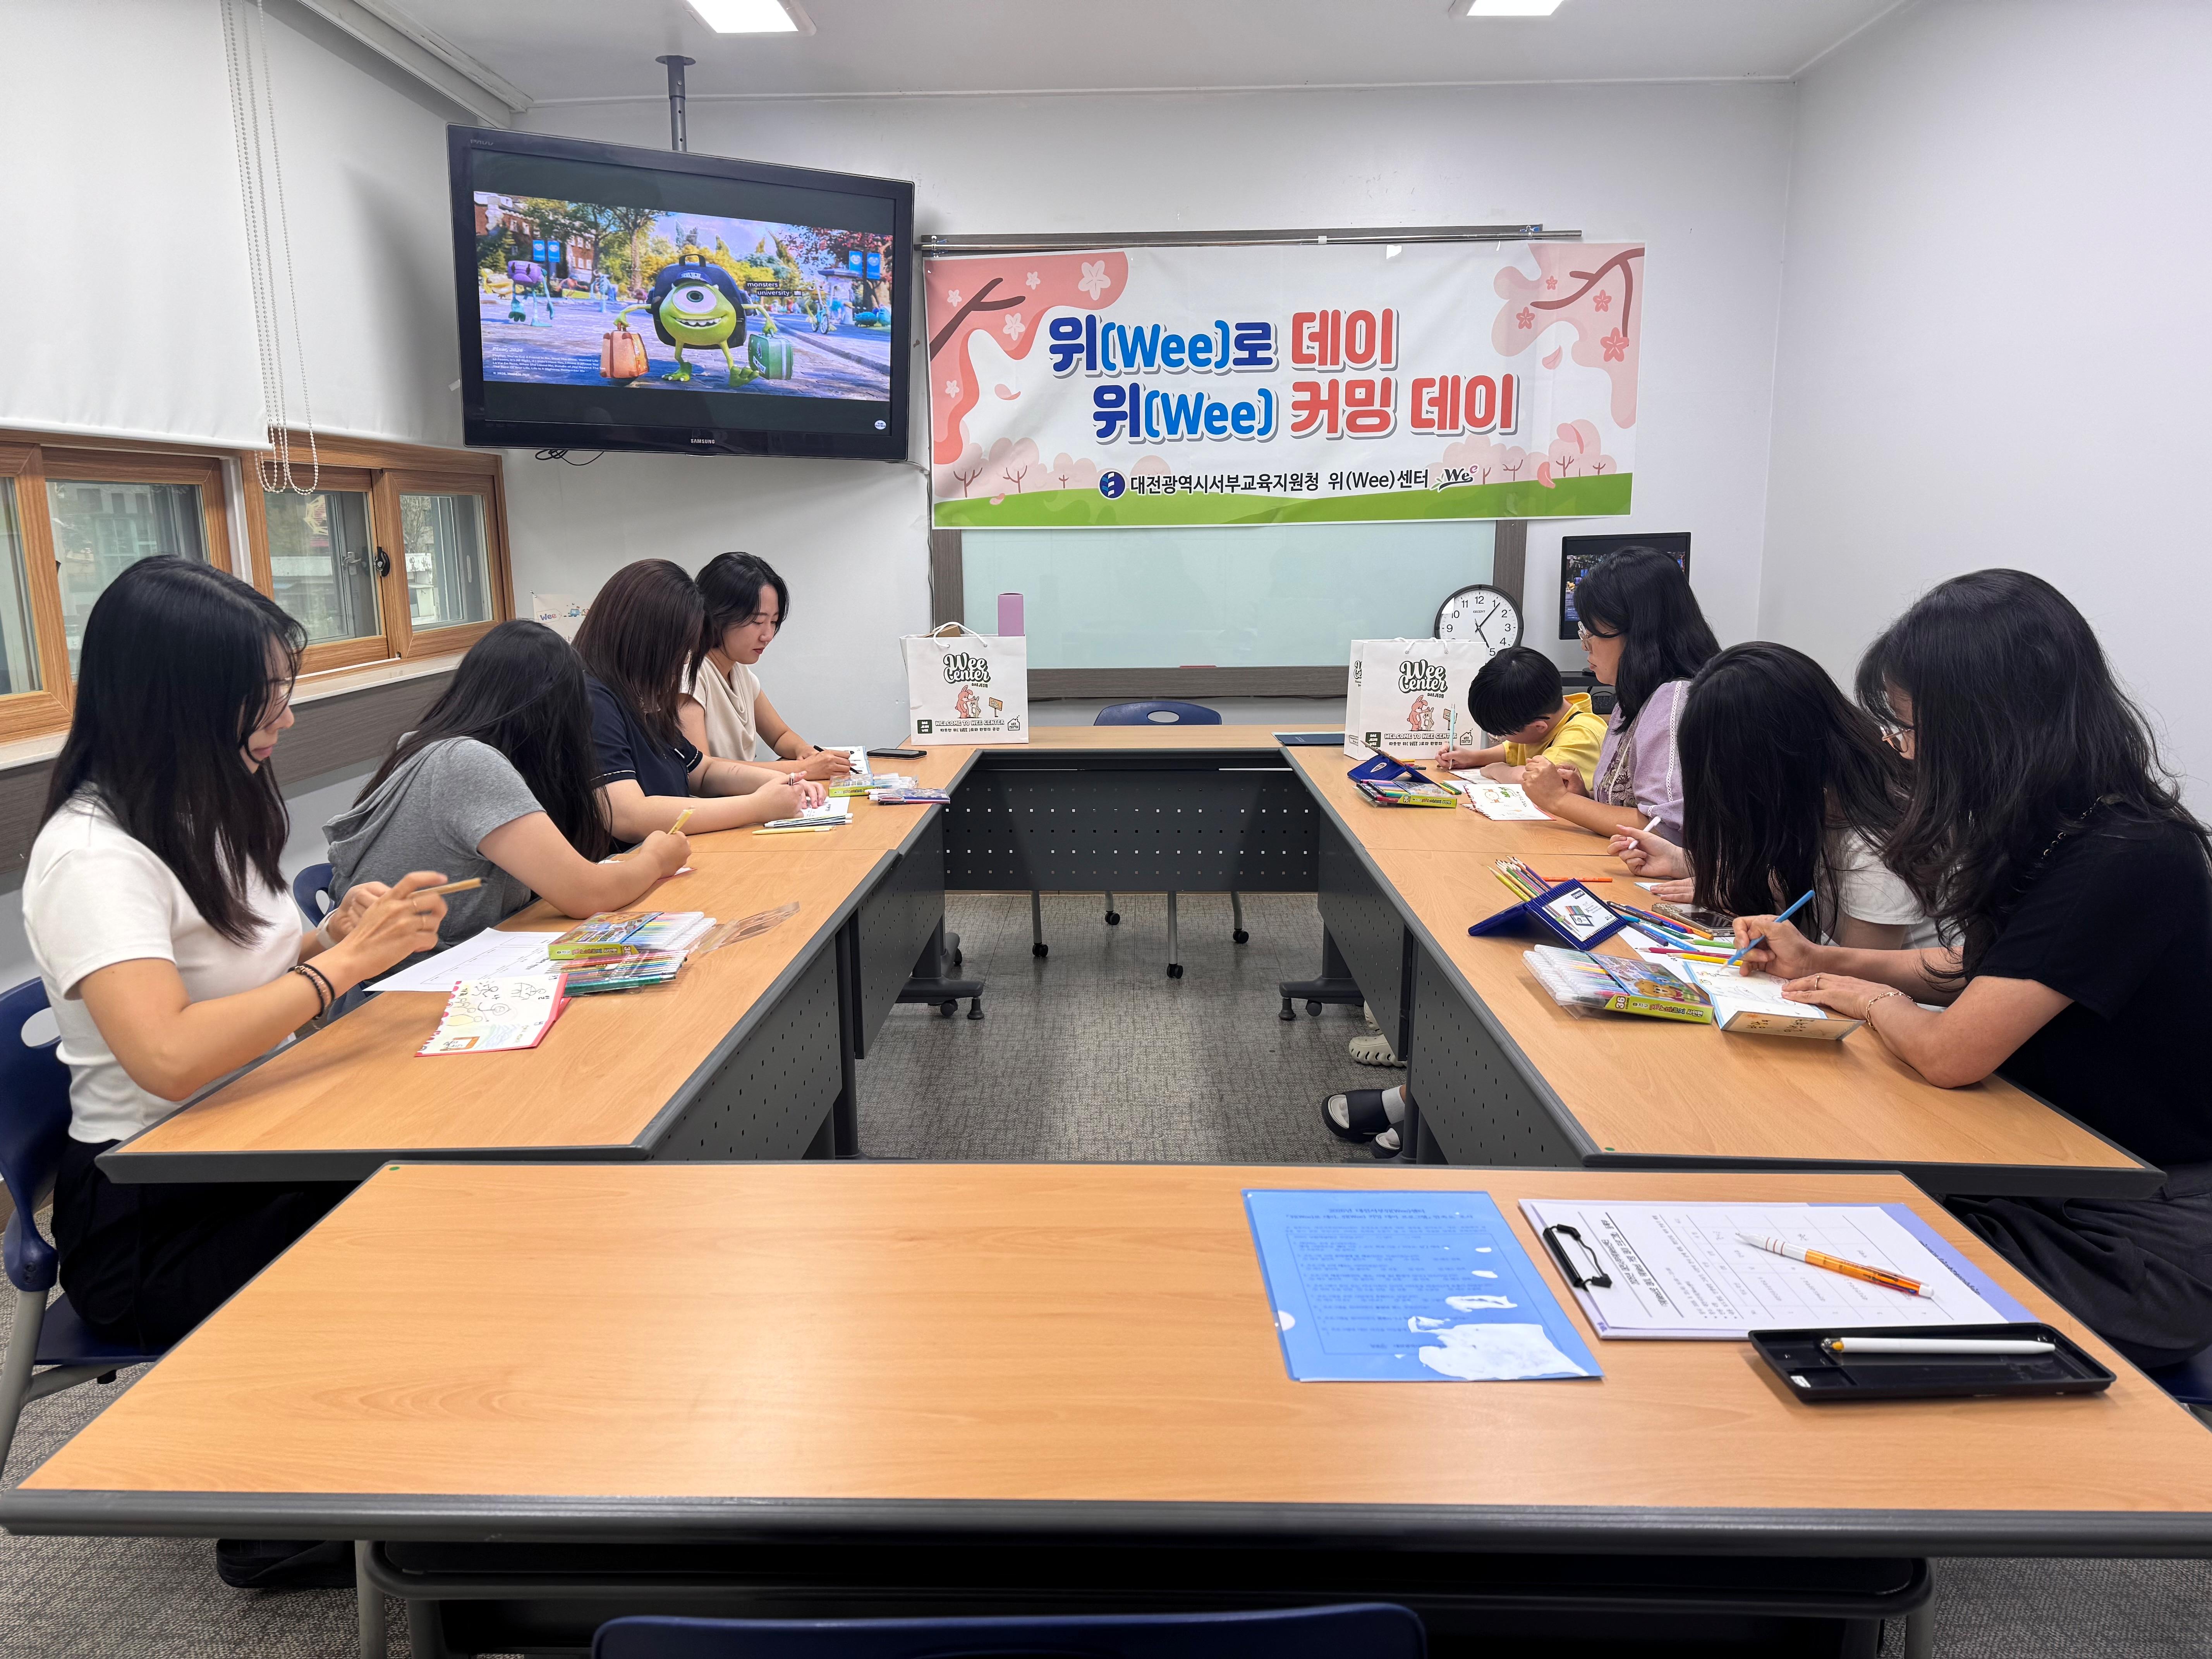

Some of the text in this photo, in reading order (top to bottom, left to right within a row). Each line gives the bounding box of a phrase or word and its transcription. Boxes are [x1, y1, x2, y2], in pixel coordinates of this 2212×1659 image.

[1049, 309, 1393, 372] 위(Wee)로 데이
[1093, 373, 1514, 438] 위(Wee) 커밍 데이
[1130, 472, 1319, 495] 대전광역시서부교육지원청
[1462, 599, 1468, 608] 11
[1475, 596, 1484, 604] 12
[1492, 599, 1496, 608] 1
[1451, 610, 1460, 618] 10
[1501, 610, 1508, 618] 2
[1446, 624, 1453, 632] 9
[1504, 623, 1511, 632] 3
[1499, 637, 1506, 646] 4
[1489, 648, 1496, 656] 5
[943, 652, 988, 672] Wee
[1399, 659, 1446, 680] Wee
[943, 666, 991, 684] Center
[1398, 674, 1448, 694] Center
[1616, 996, 1626, 1009] 36
[1687, 1009, 1704, 1017] 사인펜
